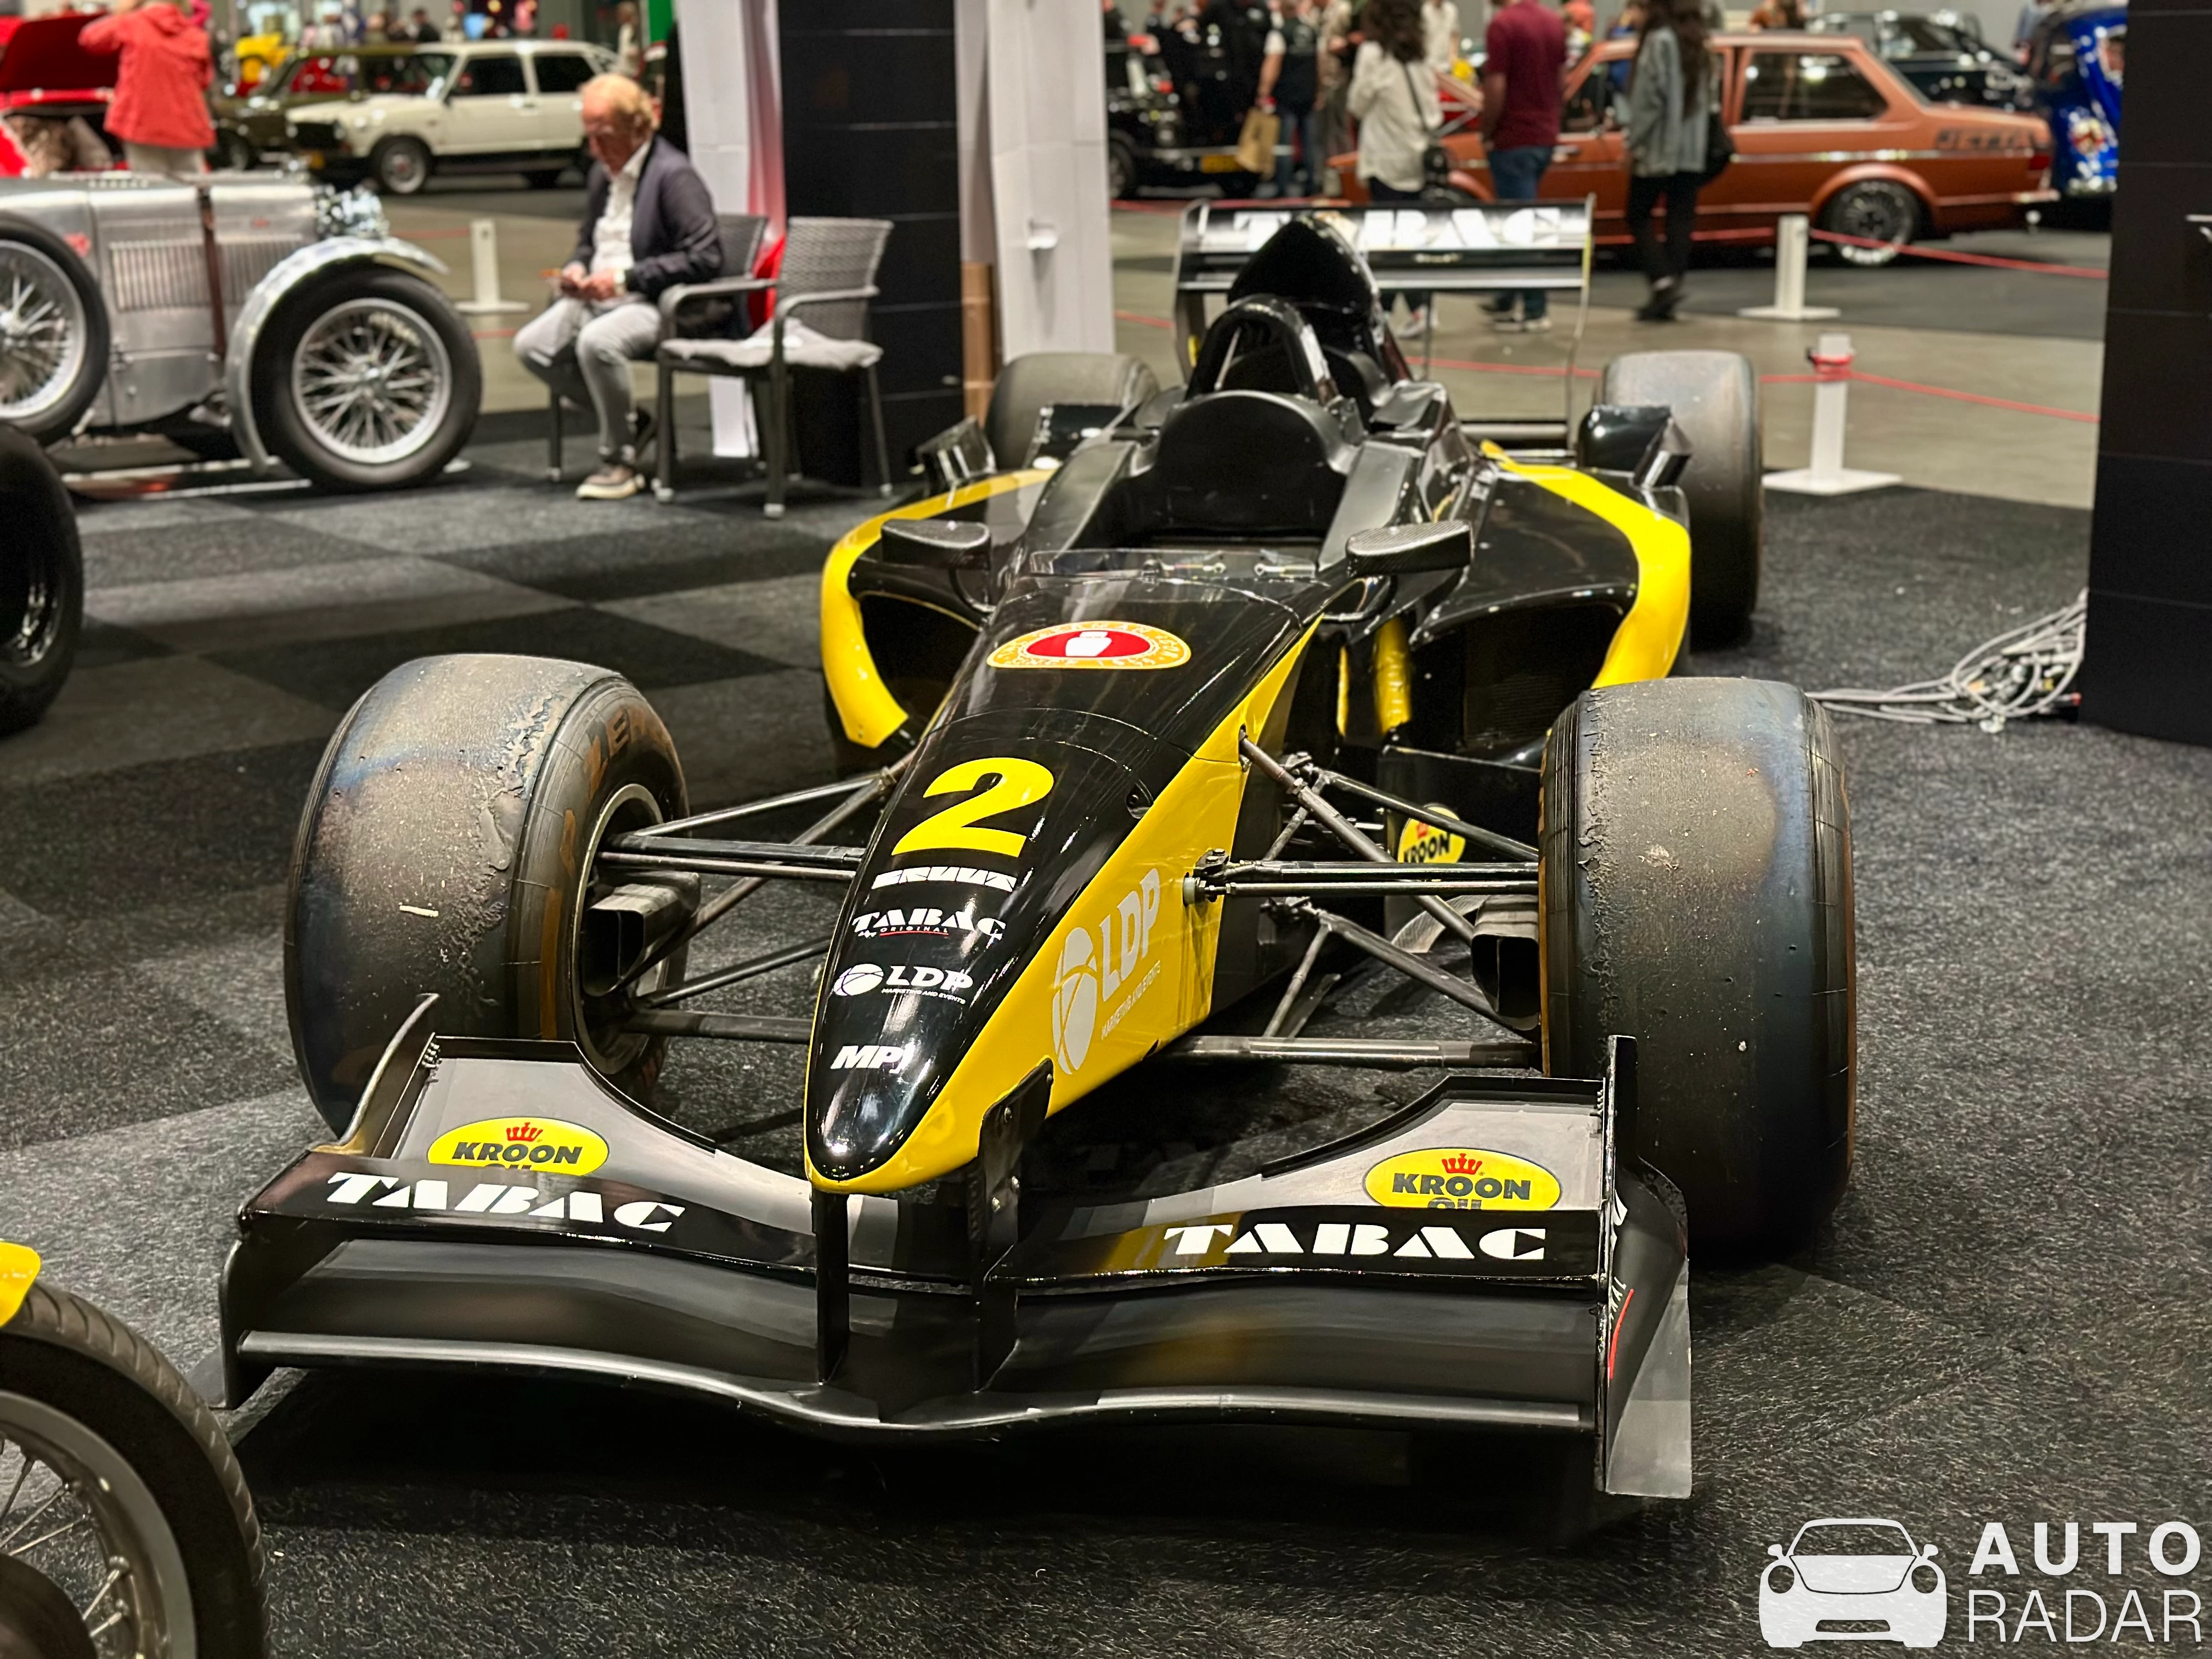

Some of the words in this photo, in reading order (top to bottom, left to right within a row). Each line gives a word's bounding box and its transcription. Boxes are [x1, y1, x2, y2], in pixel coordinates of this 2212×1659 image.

[891, 757, 1054, 857] 2
[852, 908, 1006, 940] TABAC
[1099, 868, 1160, 1002] LDP
[886, 966, 973, 991] LDP
[939, 992, 966, 1005] EVENTS
[452, 1142, 583, 1164] KROON
[327, 1172, 685, 1232] TABAC
[1392, 1173, 1531, 1200] KROON
[1164, 1223, 1546, 1260] TABAC
